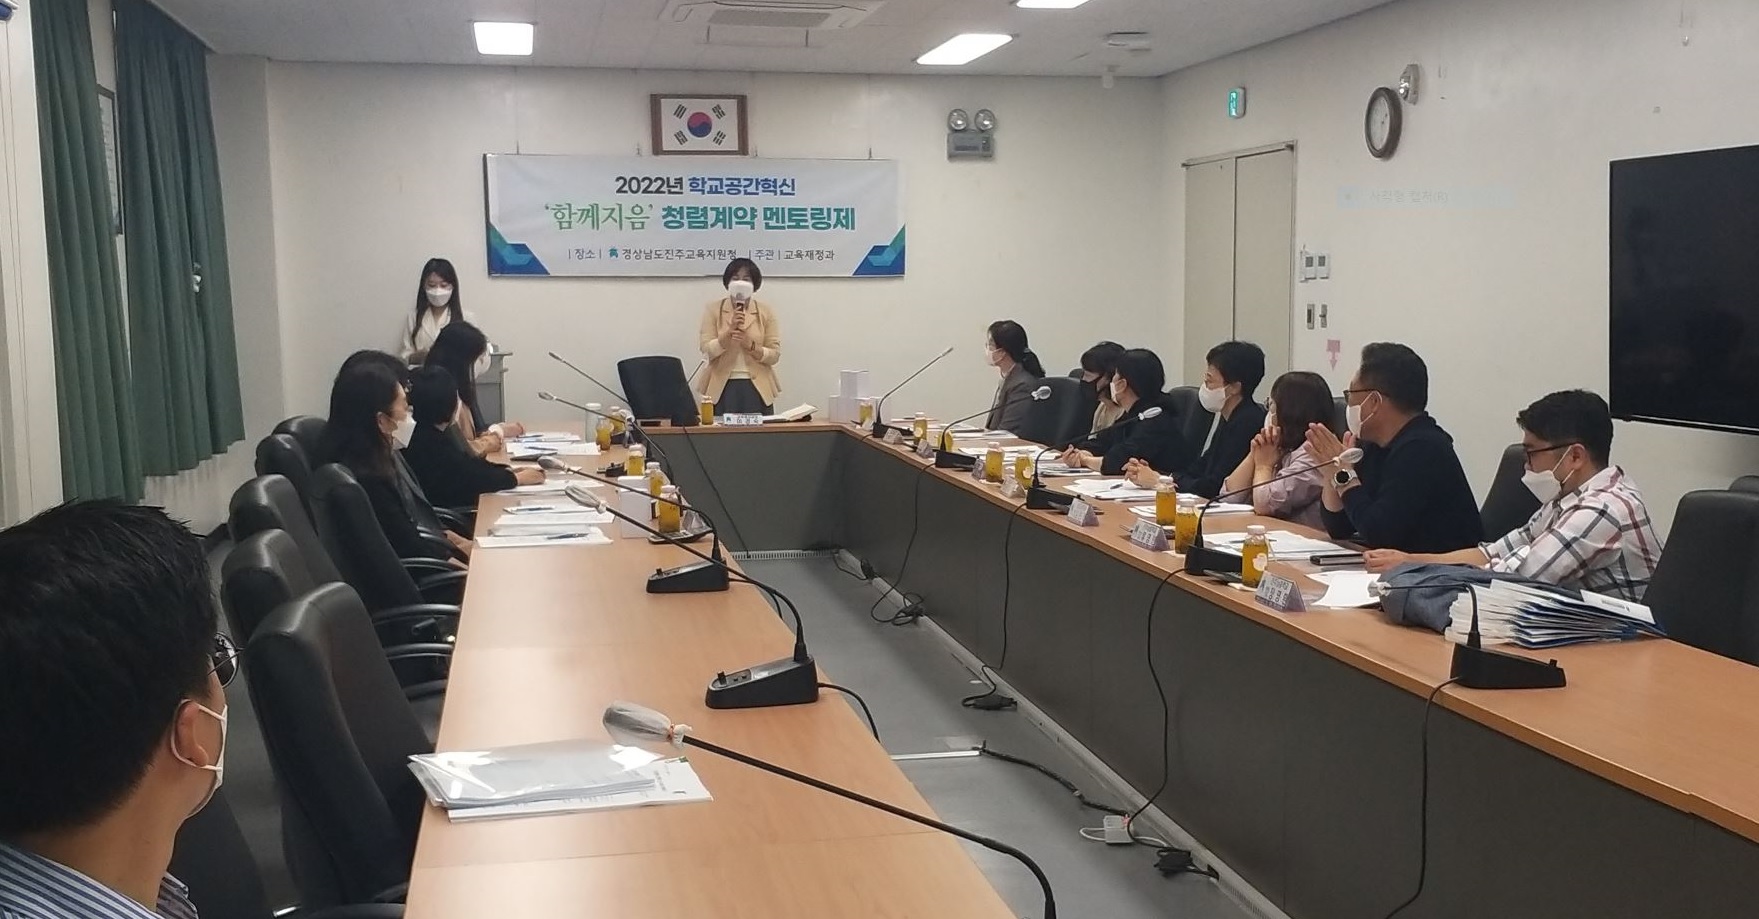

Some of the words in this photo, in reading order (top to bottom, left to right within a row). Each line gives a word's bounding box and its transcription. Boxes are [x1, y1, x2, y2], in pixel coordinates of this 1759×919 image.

[615, 176, 684, 195] 2022년
[688, 176, 796, 196] 학교공간혁신
[661, 205, 758, 231] 청렴계약
[762, 206, 855, 231] 멘토링제
[784, 249, 835, 261] 교육재정과
